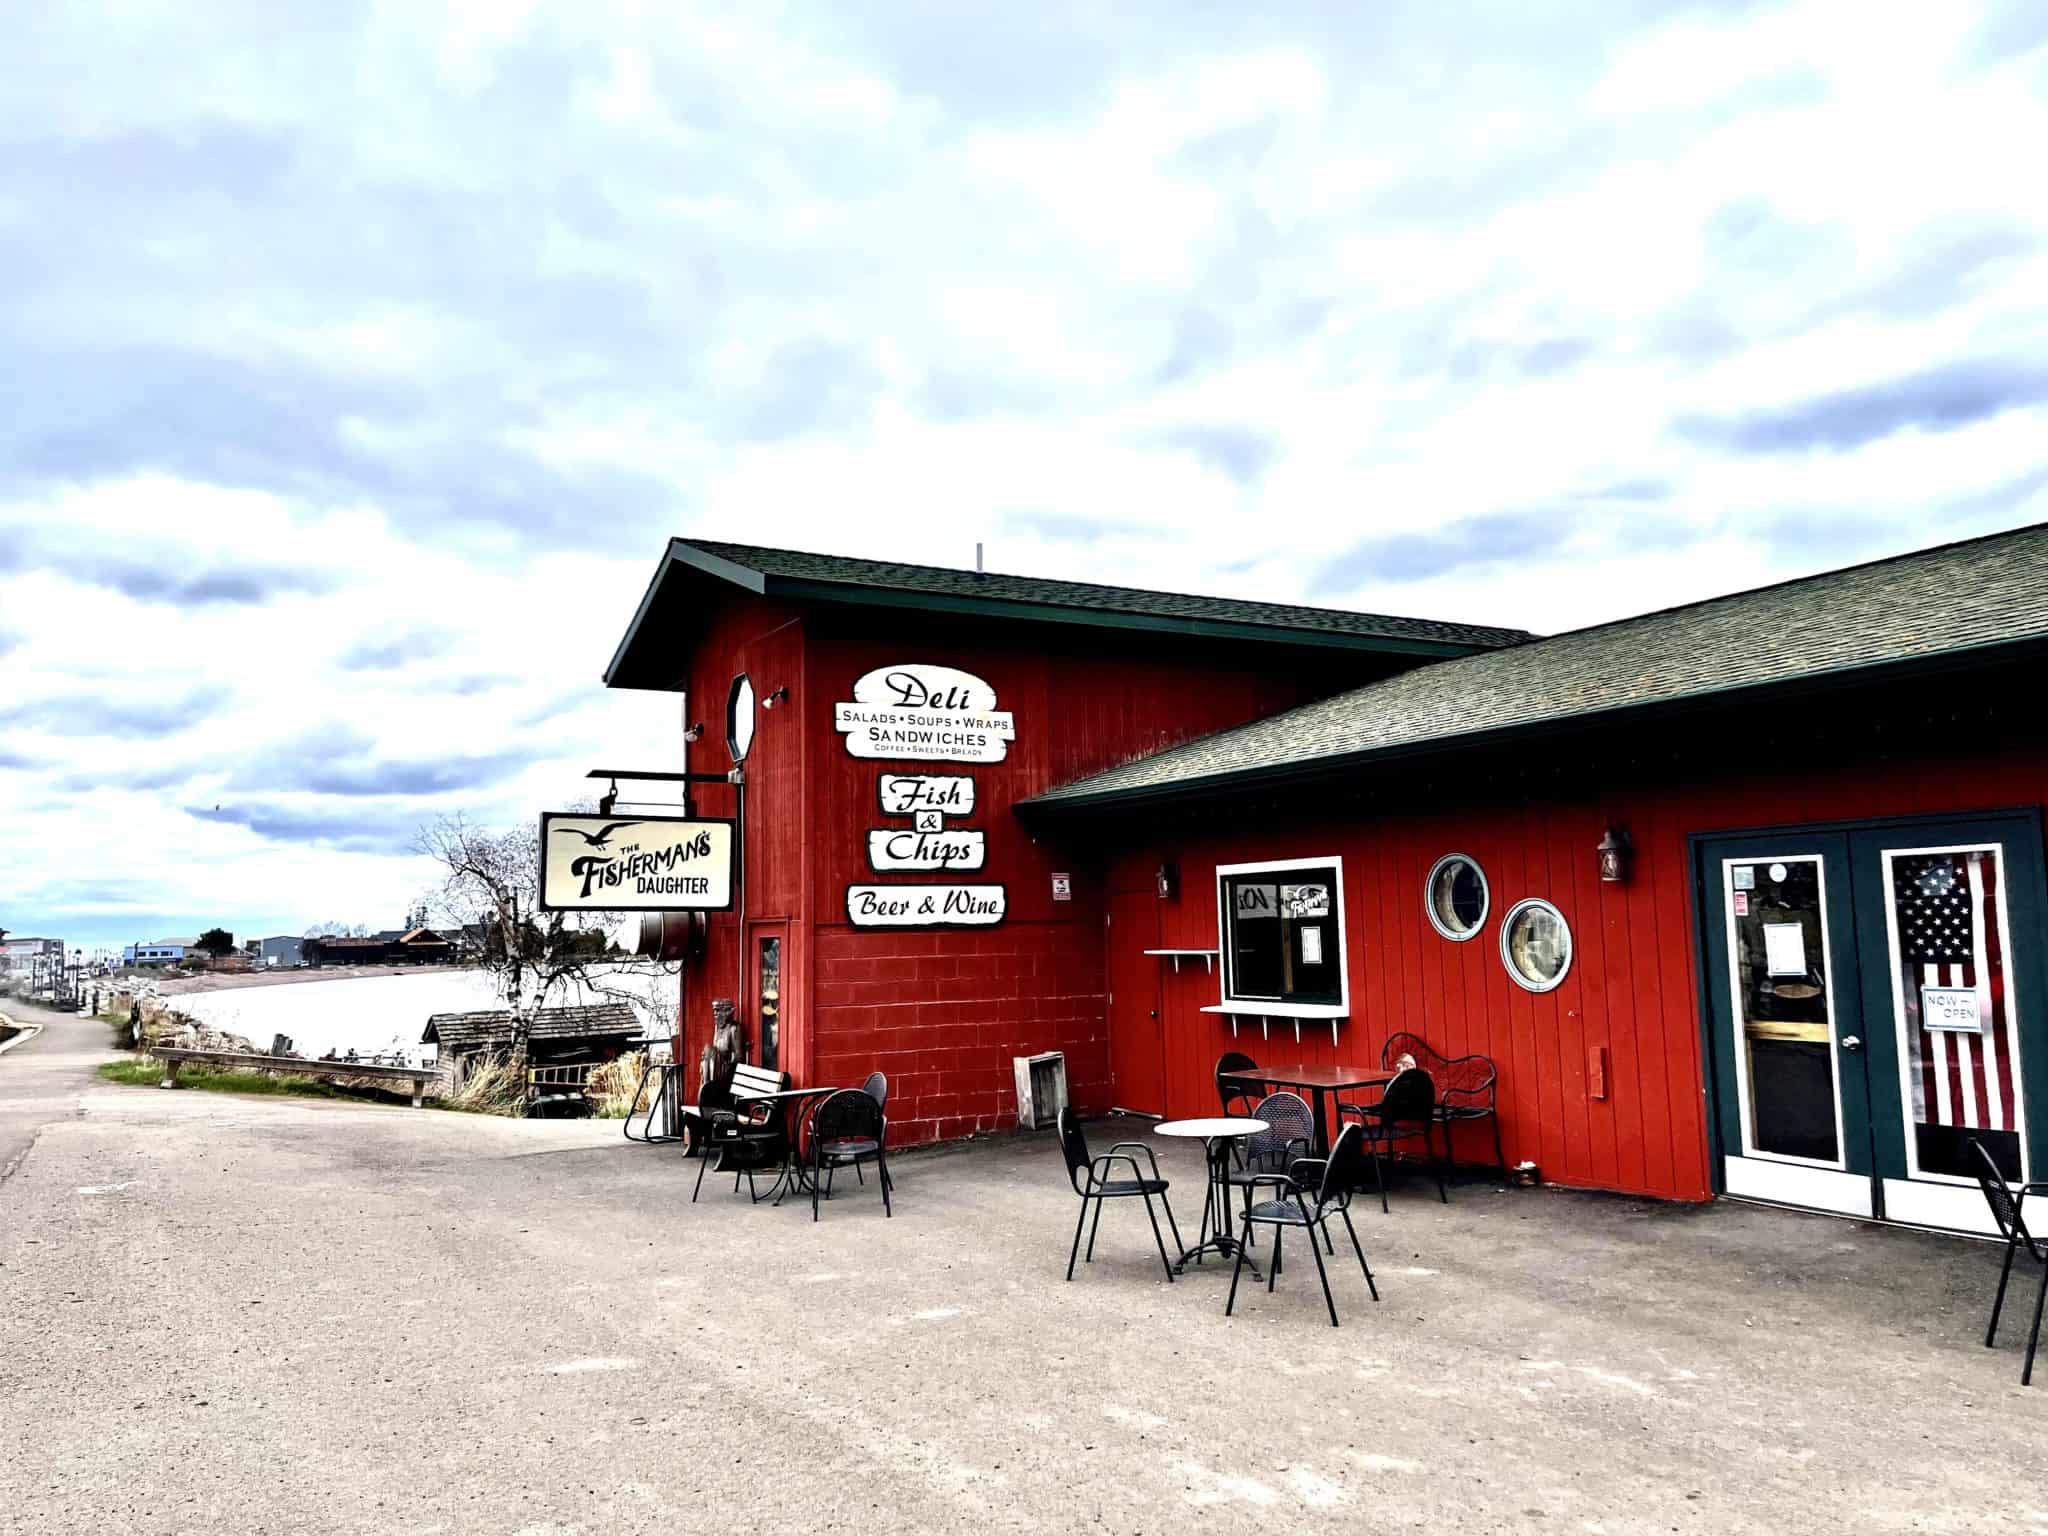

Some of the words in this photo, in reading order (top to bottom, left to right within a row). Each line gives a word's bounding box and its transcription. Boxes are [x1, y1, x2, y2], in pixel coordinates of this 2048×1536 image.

[885, 672, 971, 711] Deli
[842, 710, 897, 725] SALADS
[907, 714, 952, 728] SOUPS
[962, 717, 1009, 731] WRAPS
[868, 727, 987, 747] SANDWICHES
[889, 779, 961, 811] Fish
[919, 814, 937, 829] &
[620, 843, 640, 856] THE
[886, 834, 971, 869] Chips
[636, 876, 709, 895] DAUGHTER
[854, 890, 910, 916] Beer
[917, 895, 936, 915] &
[942, 889, 998, 915] Wine
[1927, 995, 1958, 1007] NOW
[1943, 1008, 1975, 1019] OPEN
